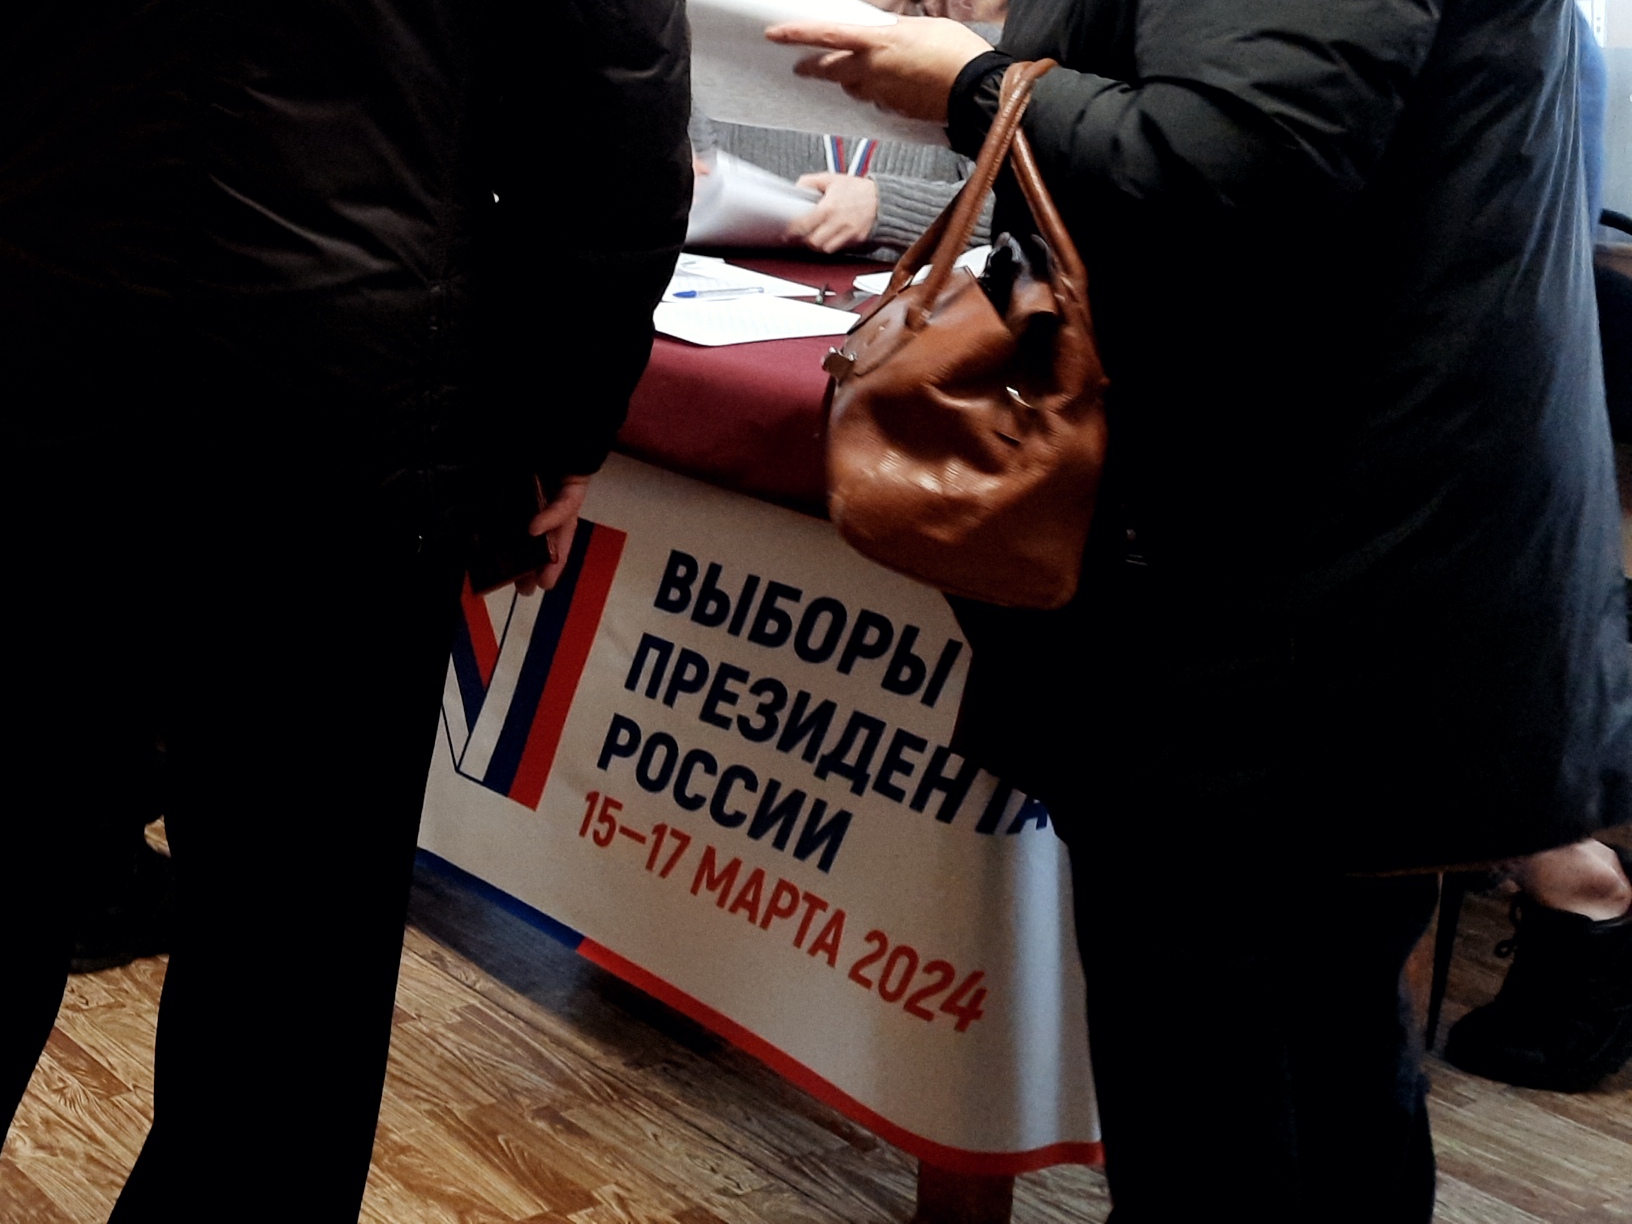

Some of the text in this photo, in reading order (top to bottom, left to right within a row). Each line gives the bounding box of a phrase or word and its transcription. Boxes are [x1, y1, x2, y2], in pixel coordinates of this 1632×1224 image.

[653, 548, 965, 709] ВЫБОРЫ
[596, 712, 855, 875] РОССИИ
[689, 845, 848, 967] МАРТА
[847, 929, 989, 1033] 2024
